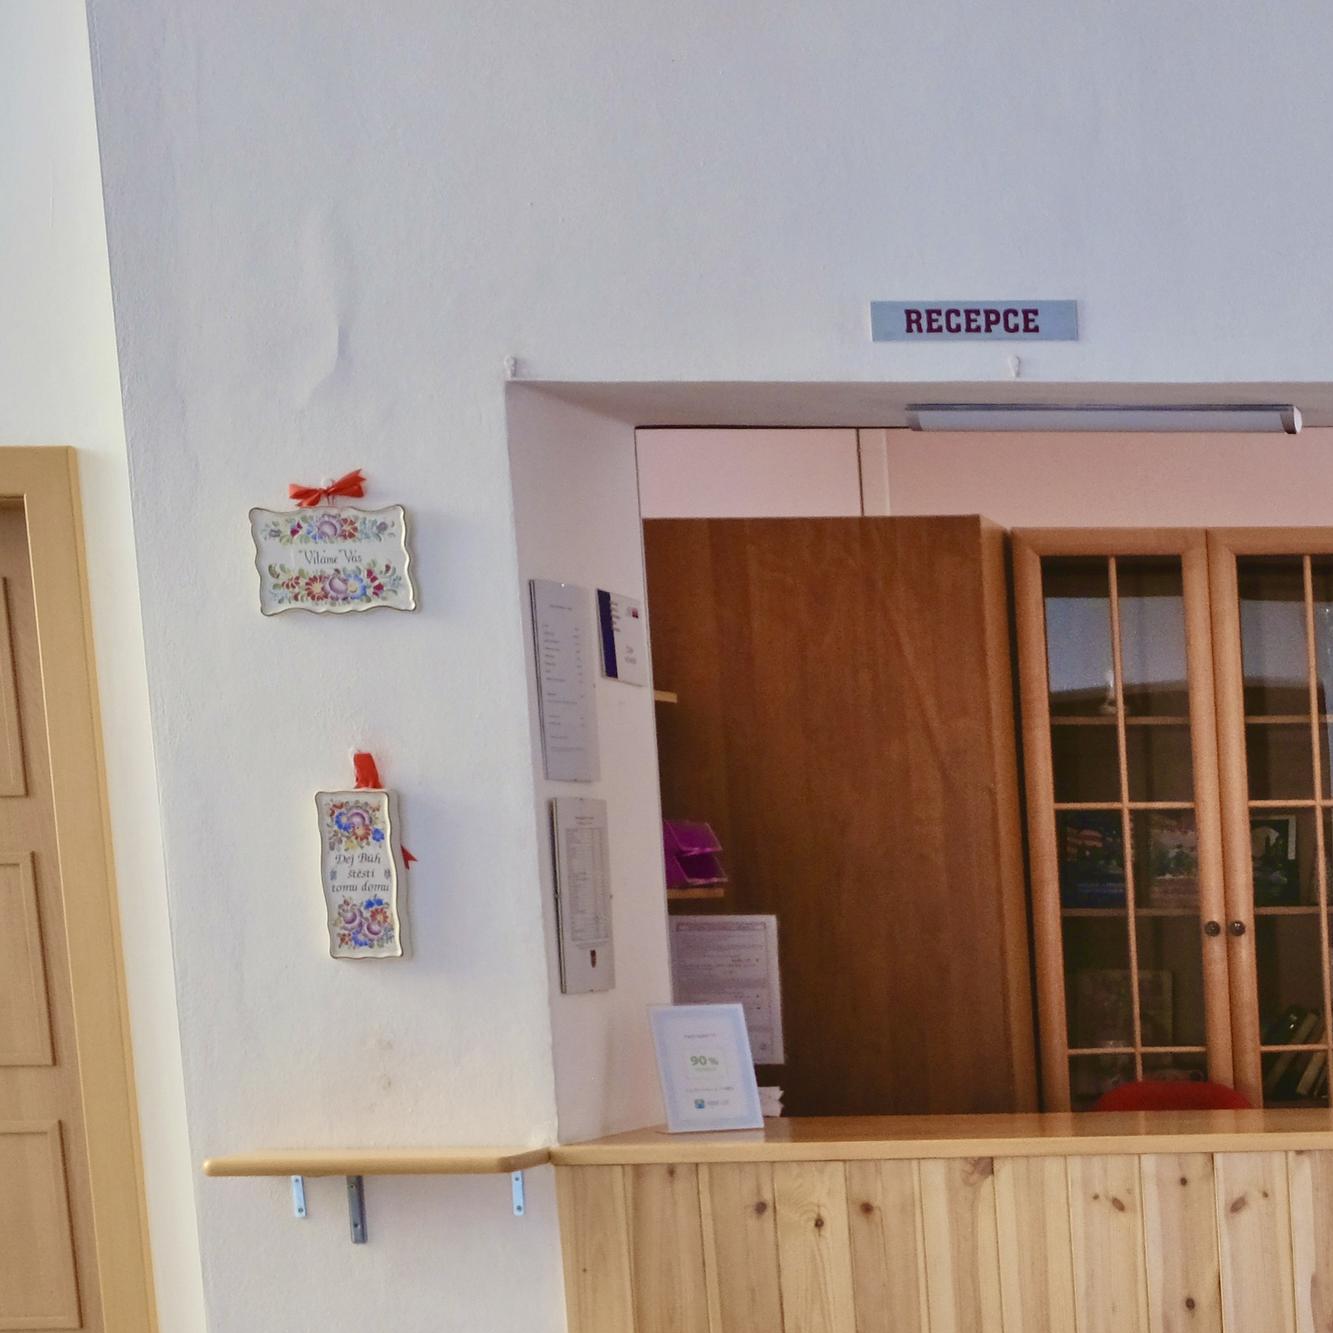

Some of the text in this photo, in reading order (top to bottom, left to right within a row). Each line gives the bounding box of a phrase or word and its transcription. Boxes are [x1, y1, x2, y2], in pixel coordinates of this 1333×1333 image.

[904, 308, 1040, 333] RECEPCE
[331, 882, 390, 893] tomu domu
